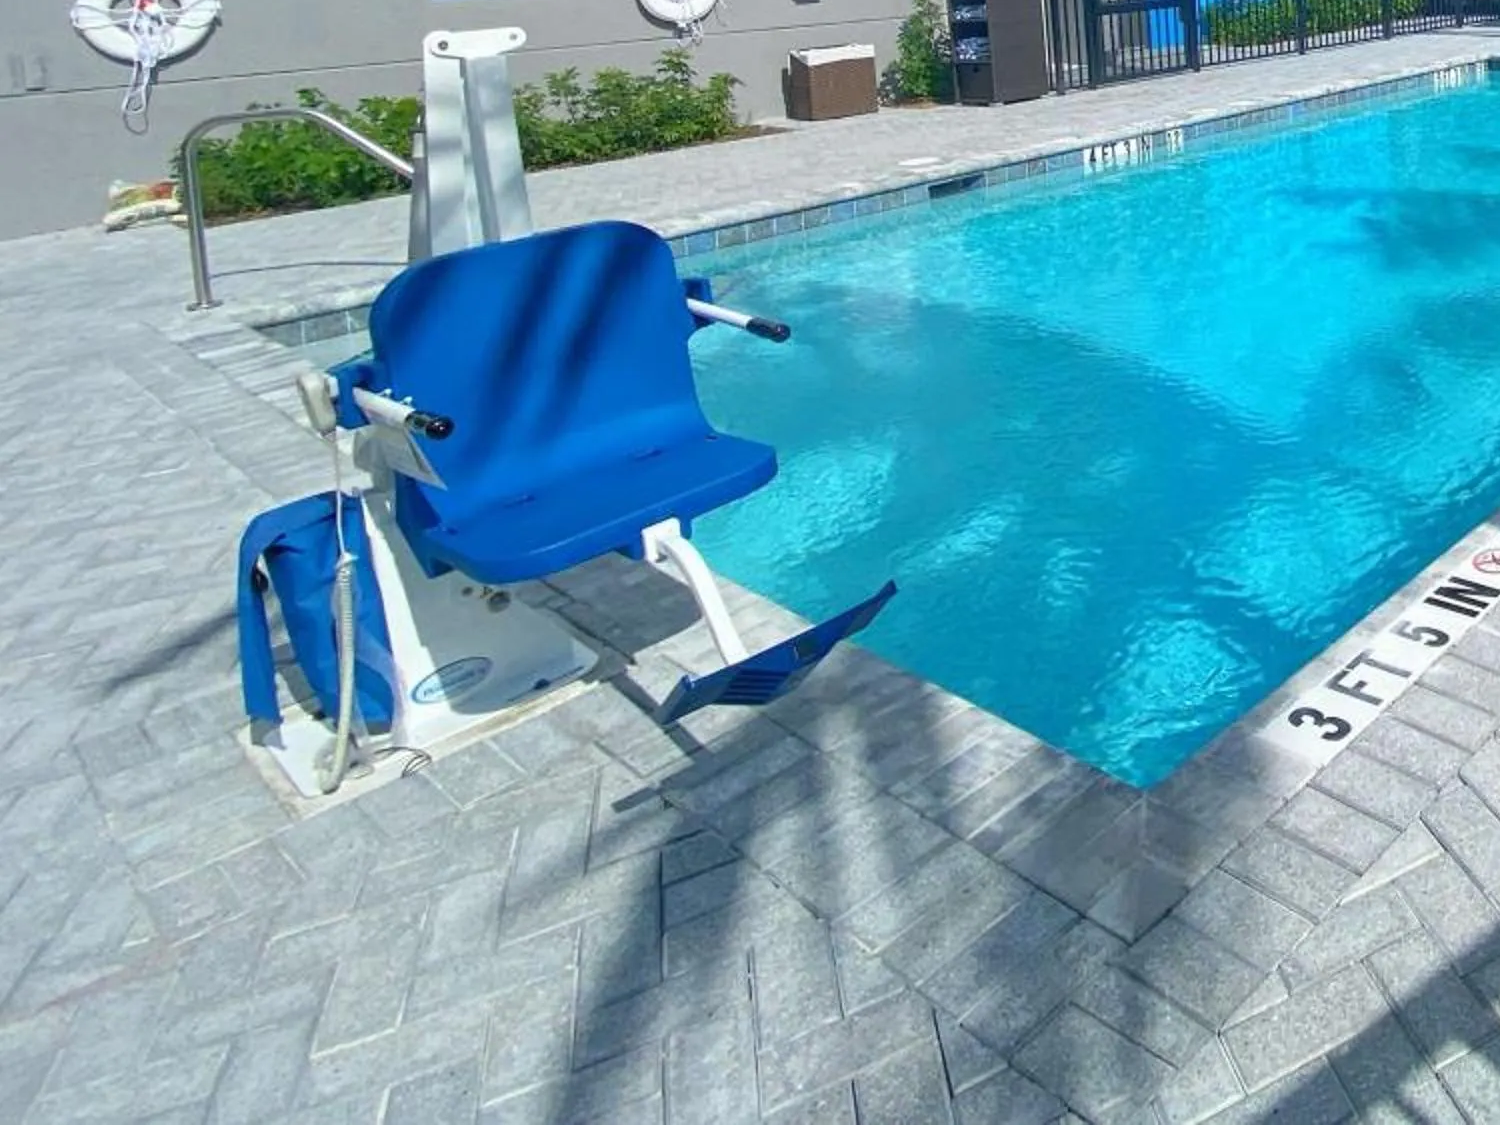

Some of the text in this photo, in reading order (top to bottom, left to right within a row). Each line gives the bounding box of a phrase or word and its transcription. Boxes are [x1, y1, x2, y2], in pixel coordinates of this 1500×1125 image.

[1288, 707, 1352, 742] 3
[1324, 648, 1412, 706] FT
[1390, 621, 1449, 647] 5
